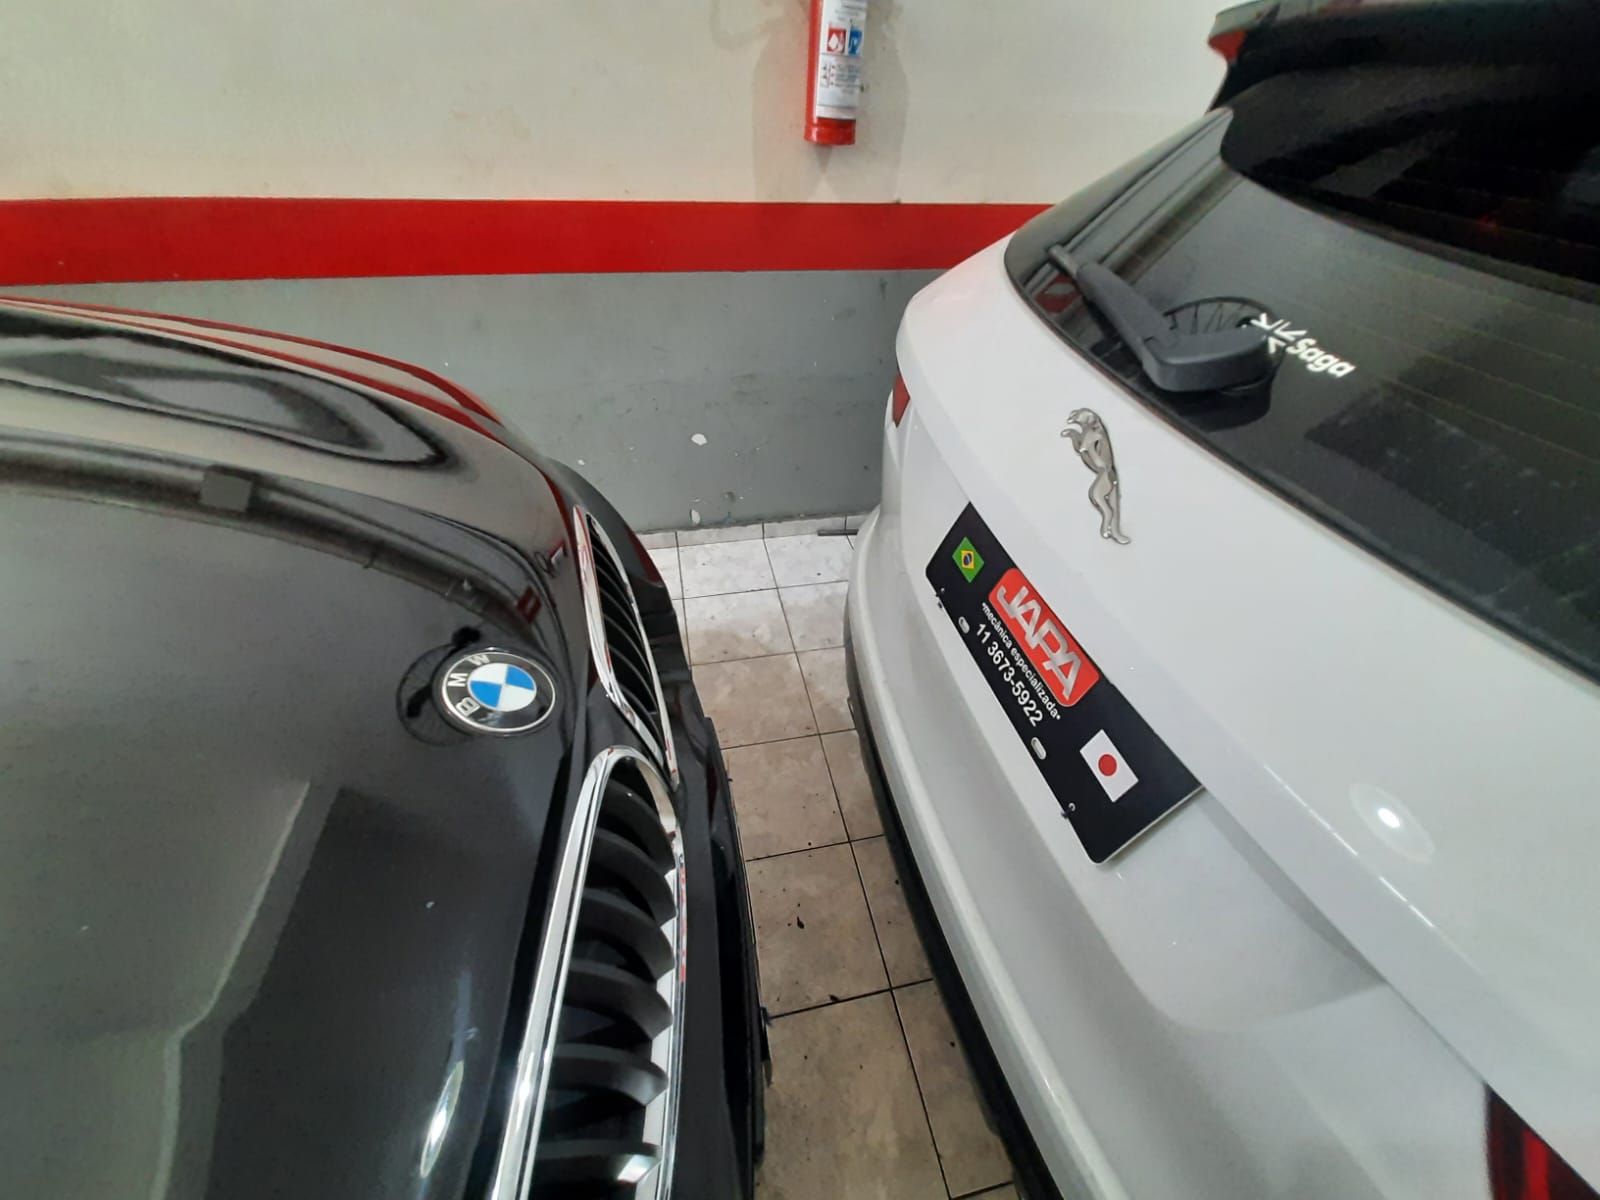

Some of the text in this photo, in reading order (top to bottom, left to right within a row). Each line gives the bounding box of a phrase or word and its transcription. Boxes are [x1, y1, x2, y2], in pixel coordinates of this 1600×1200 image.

[1286, 338, 1356, 377] Saga
[976, 623, 1043, 727] 11 3673-5922
[997, 585, 1081, 701] JAPA
[447, 654, 490, 717] BMW
